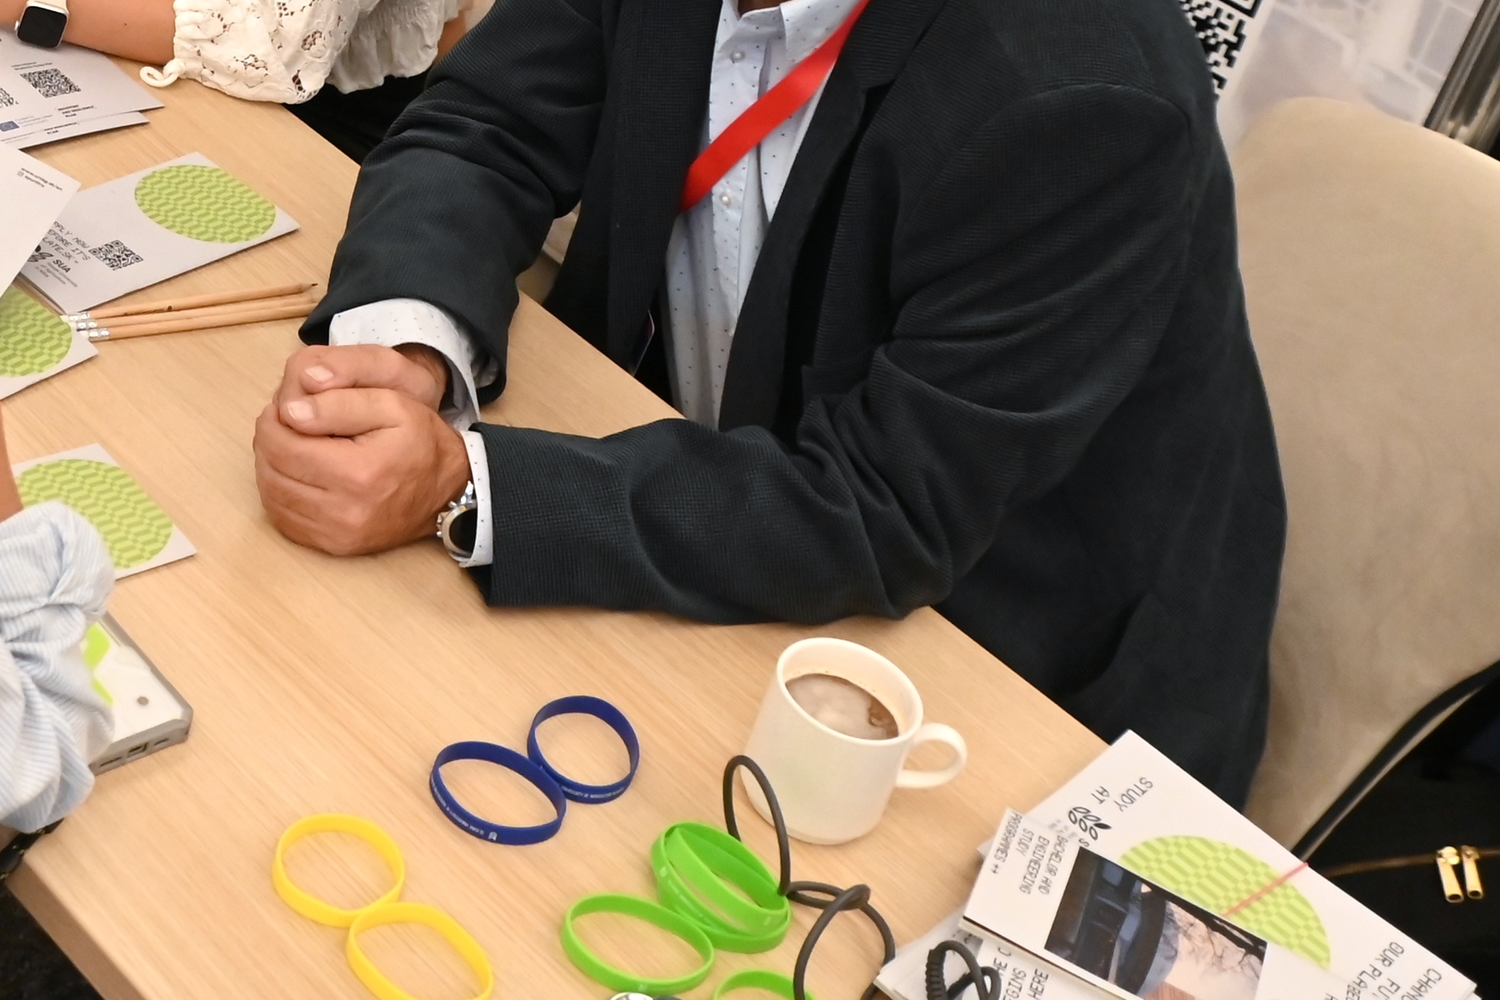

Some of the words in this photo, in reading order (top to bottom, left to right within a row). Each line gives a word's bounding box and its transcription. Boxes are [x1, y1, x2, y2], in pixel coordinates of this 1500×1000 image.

[53, 259, 71, 273] SUA
[1091, 785, 1111, 805] AT
[1113, 776, 1154, 812] STUDY
[994, 811, 1023, 863] PROGRAMMES
[1016, 828, 1035, 857] STUDY
[1019, 835, 1050, 895] ENGINEERING
[1046, 834, 1069, 877] BACHELOR
[1038, 875, 1053, 895] AND
[1375, 941, 1405, 968] OUR
